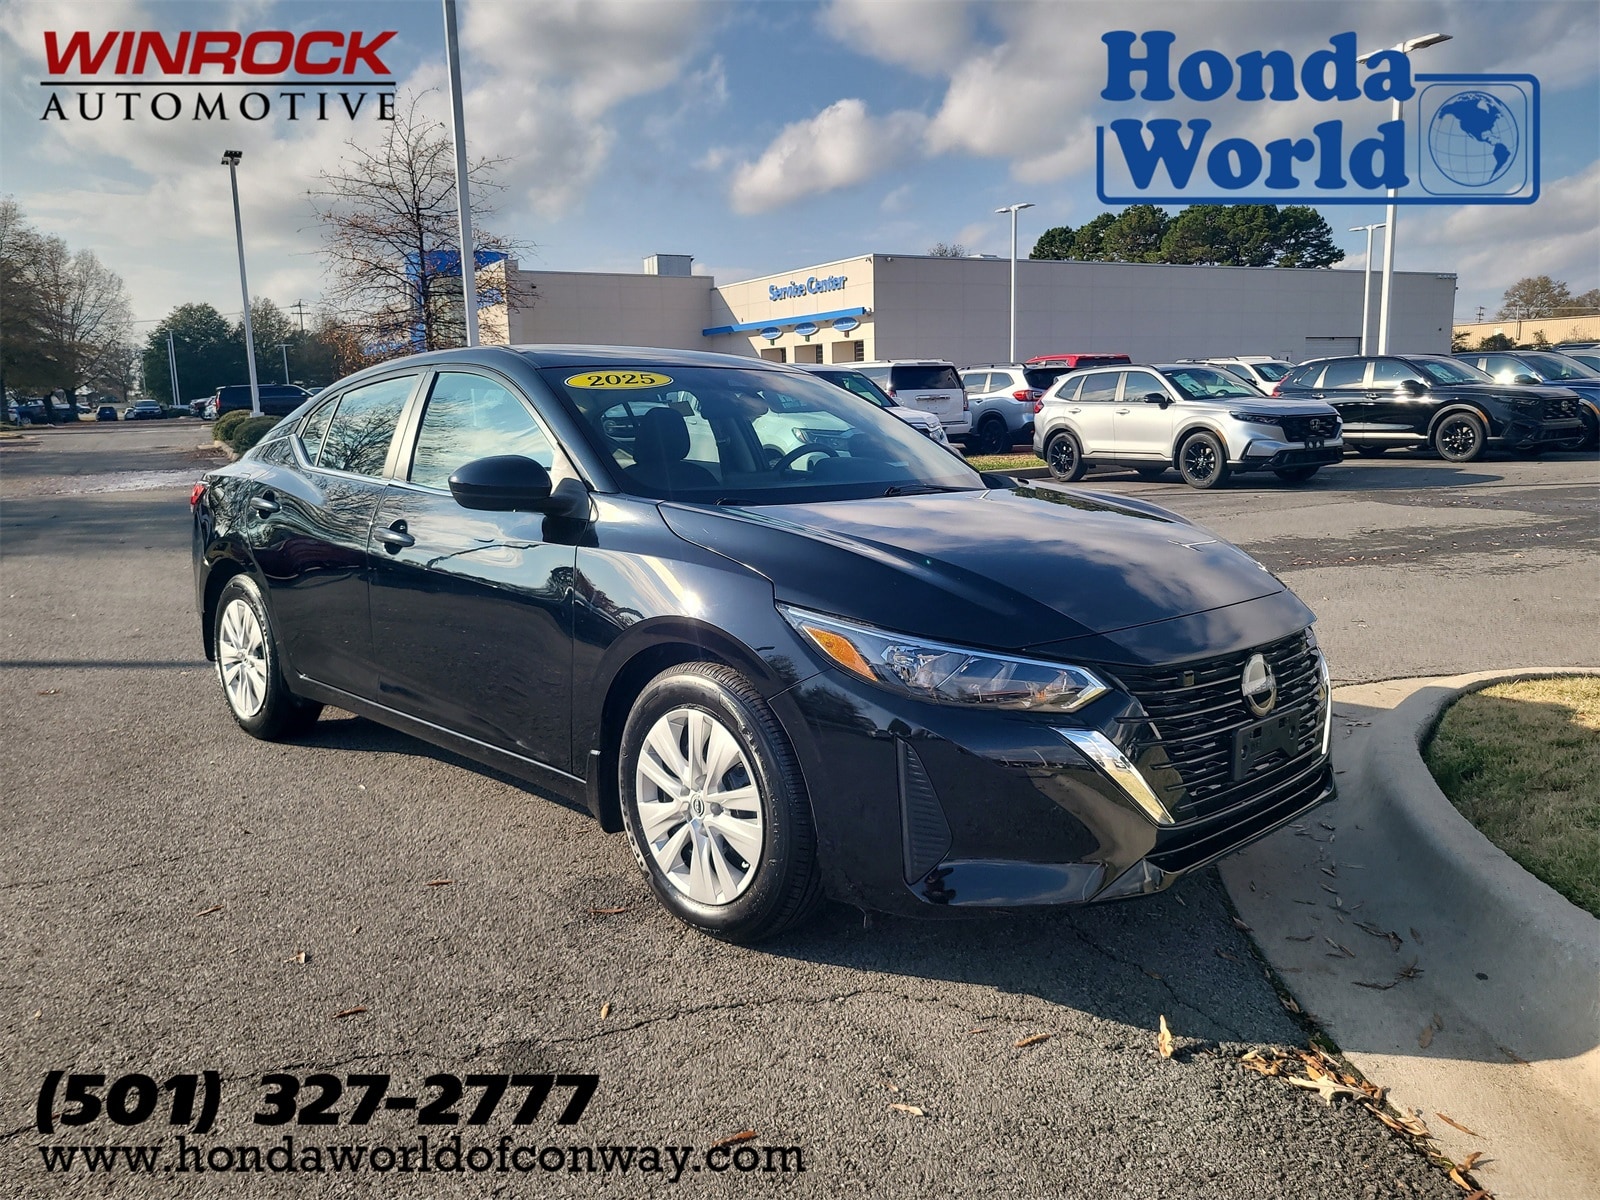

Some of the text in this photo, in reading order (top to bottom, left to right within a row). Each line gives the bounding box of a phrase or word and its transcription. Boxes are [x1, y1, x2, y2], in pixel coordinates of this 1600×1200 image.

[768, 275, 848, 302] Service Center
[587, 373, 656, 387] 2025
